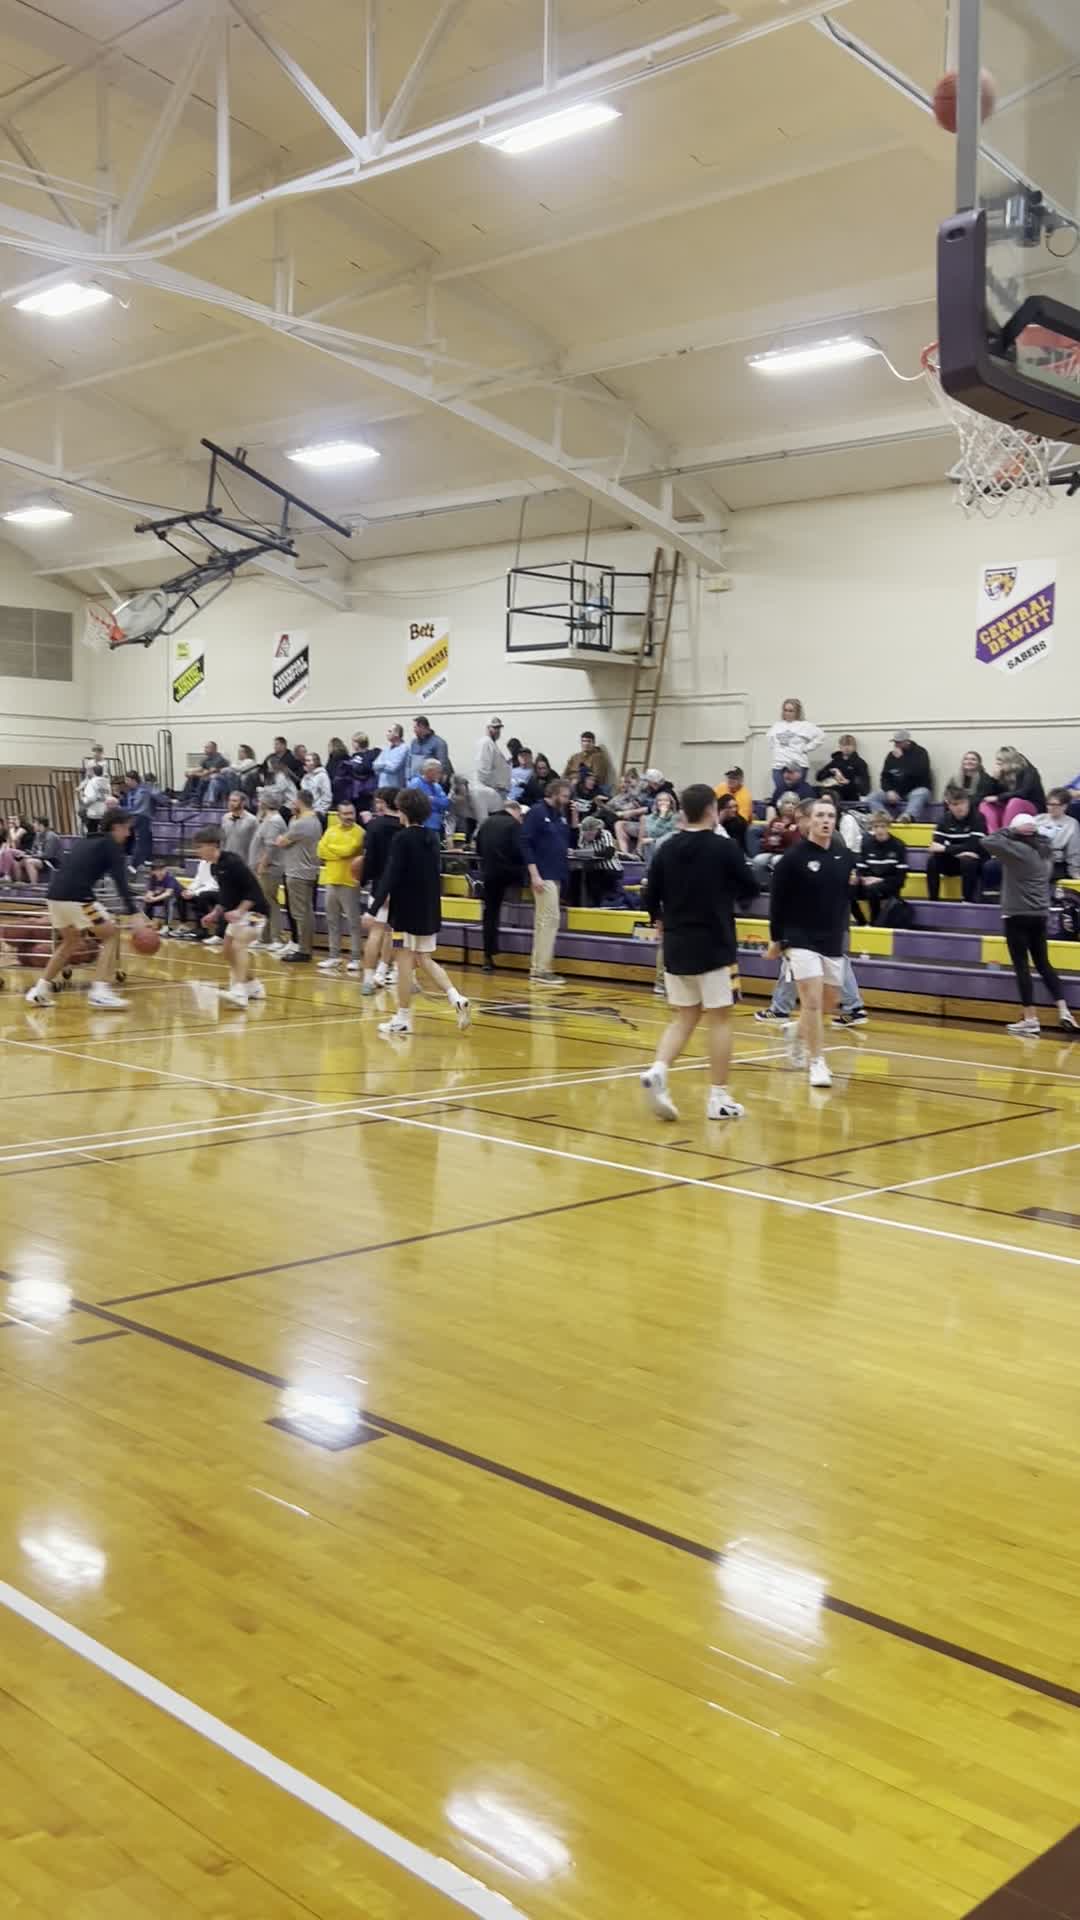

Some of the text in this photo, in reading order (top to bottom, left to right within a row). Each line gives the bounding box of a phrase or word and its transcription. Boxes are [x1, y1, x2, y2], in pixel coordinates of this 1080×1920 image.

[980, 595, 1052, 645] CENTRAL
[988, 609, 1051, 655] DEWITT
[1007, 640, 1047, 669] SABERS
